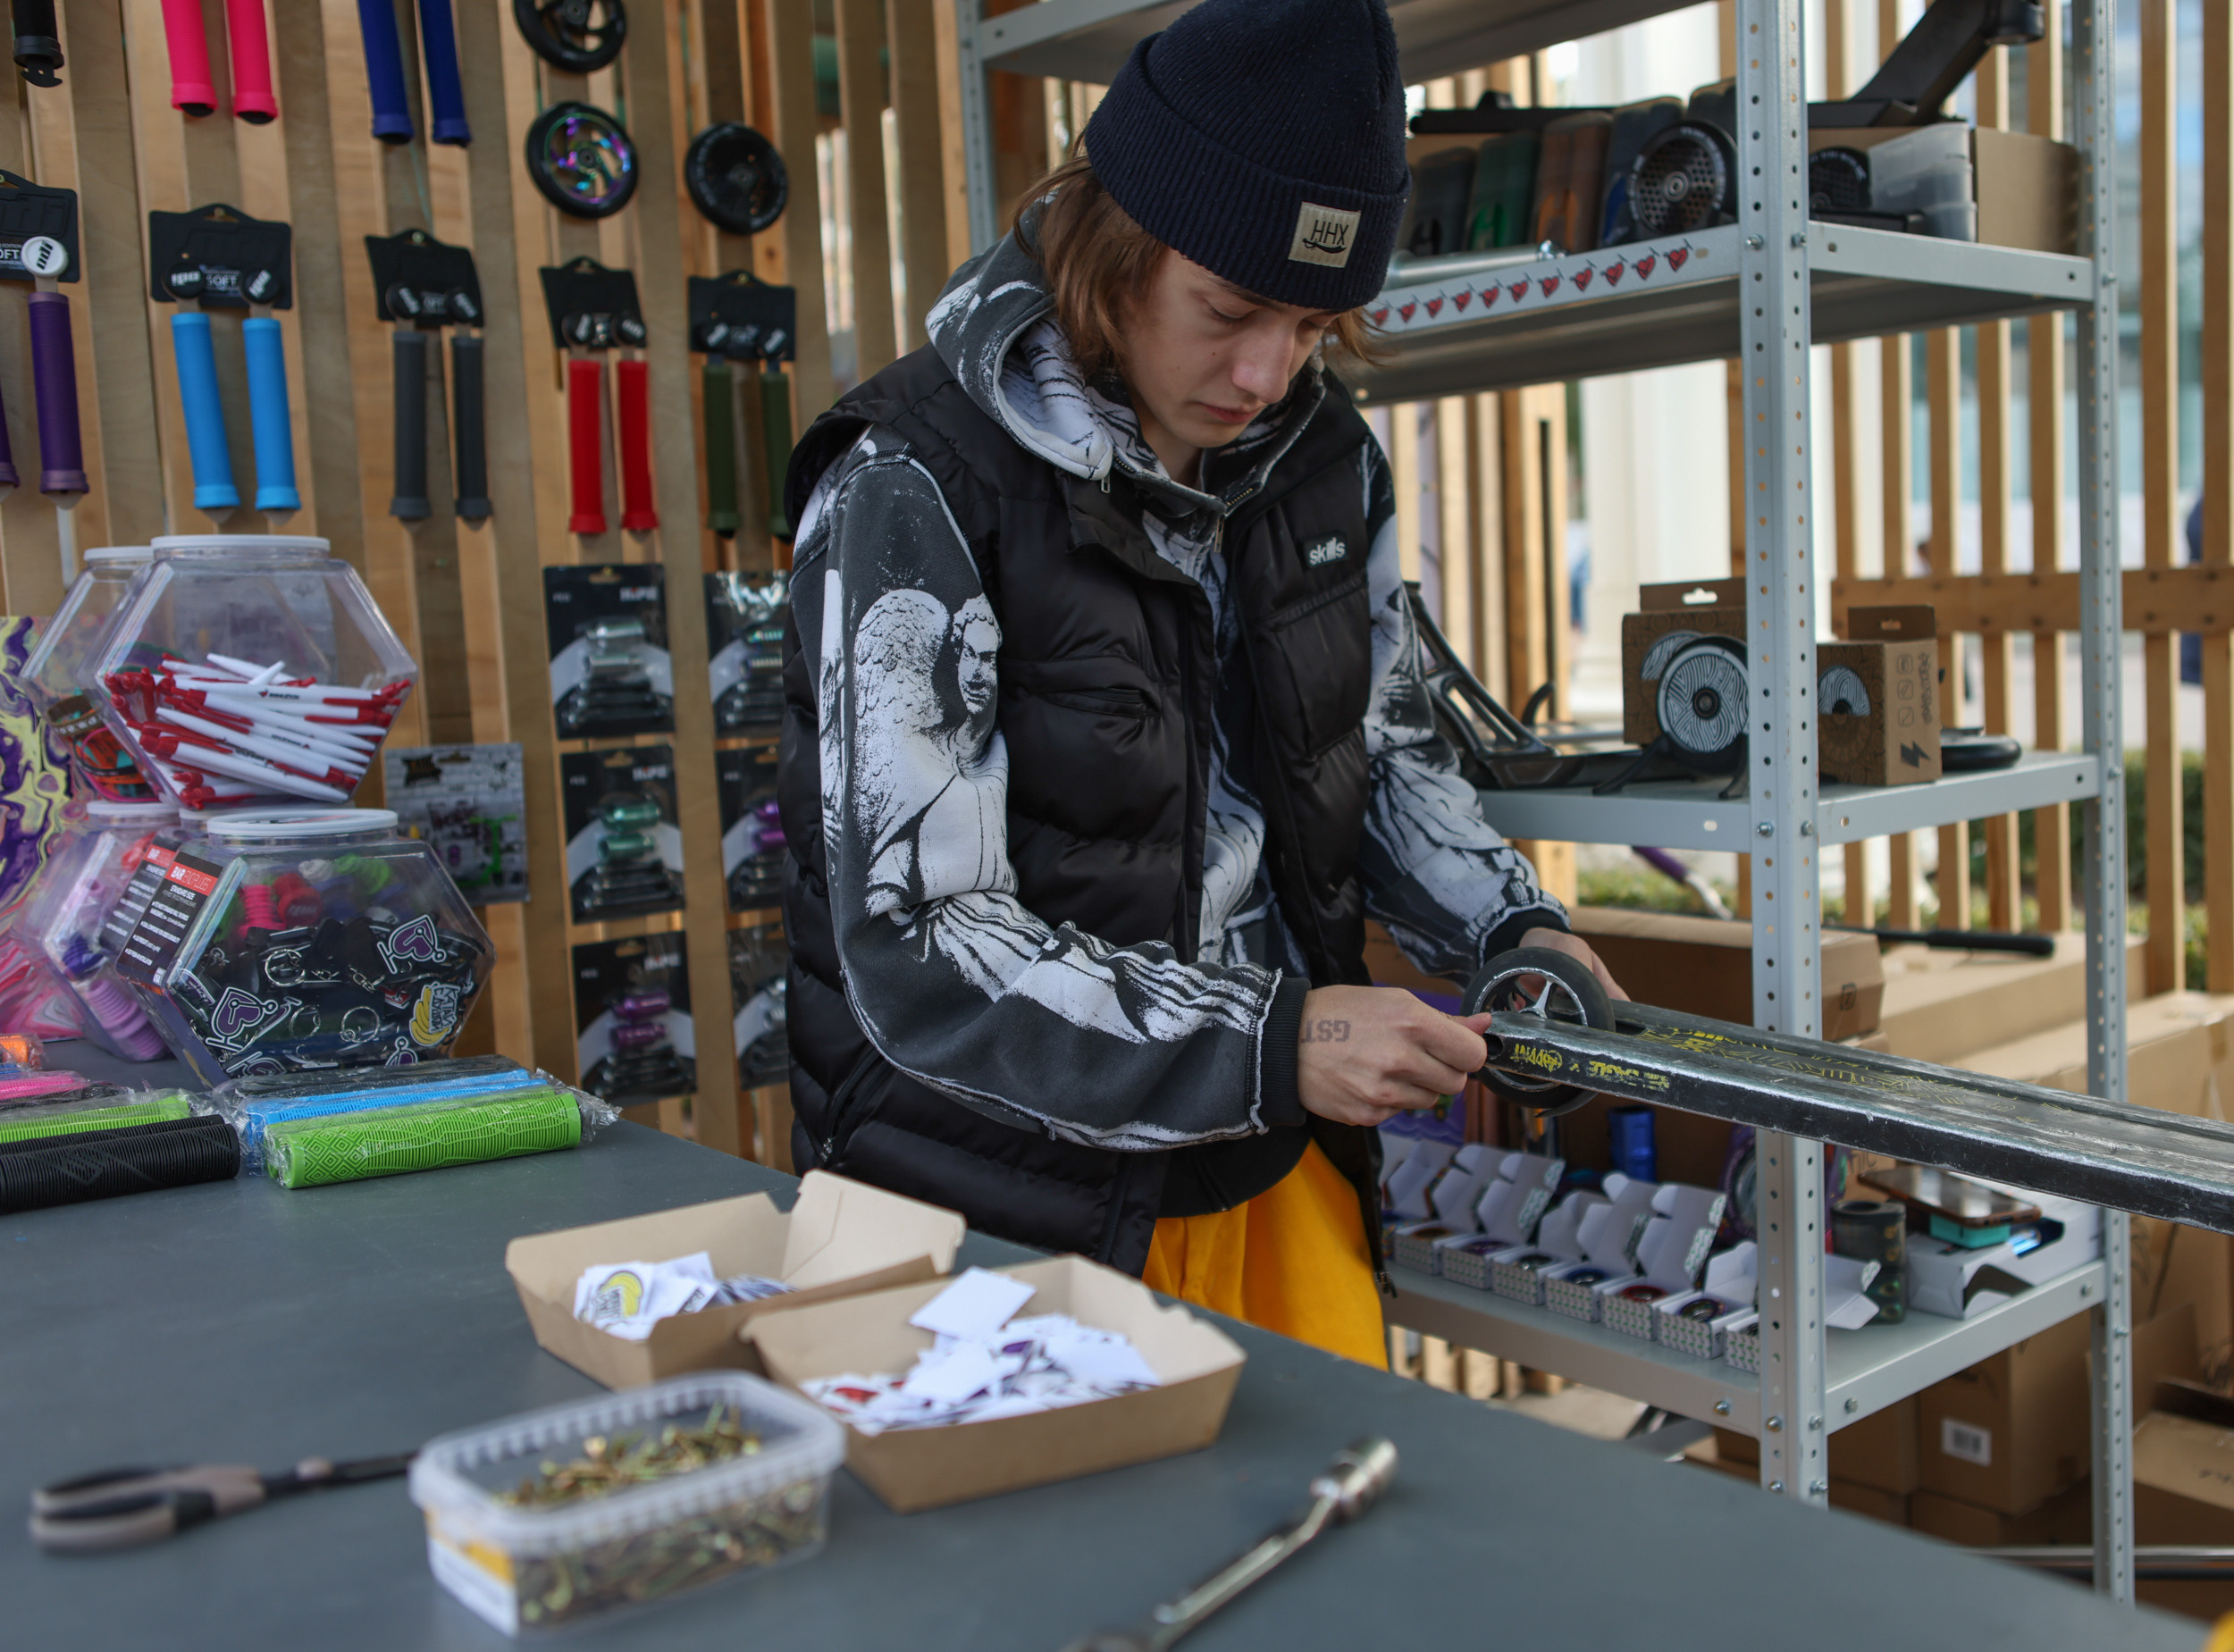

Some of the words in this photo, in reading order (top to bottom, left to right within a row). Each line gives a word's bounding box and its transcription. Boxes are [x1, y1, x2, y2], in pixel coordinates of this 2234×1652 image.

[1310, 220, 1349, 246] HHX
[206, 274, 237, 286] SOFT
[1309, 537, 1346, 565] skills
[171, 866, 187, 881] BAR
[441, 986, 459, 1027] КАТАЙ
